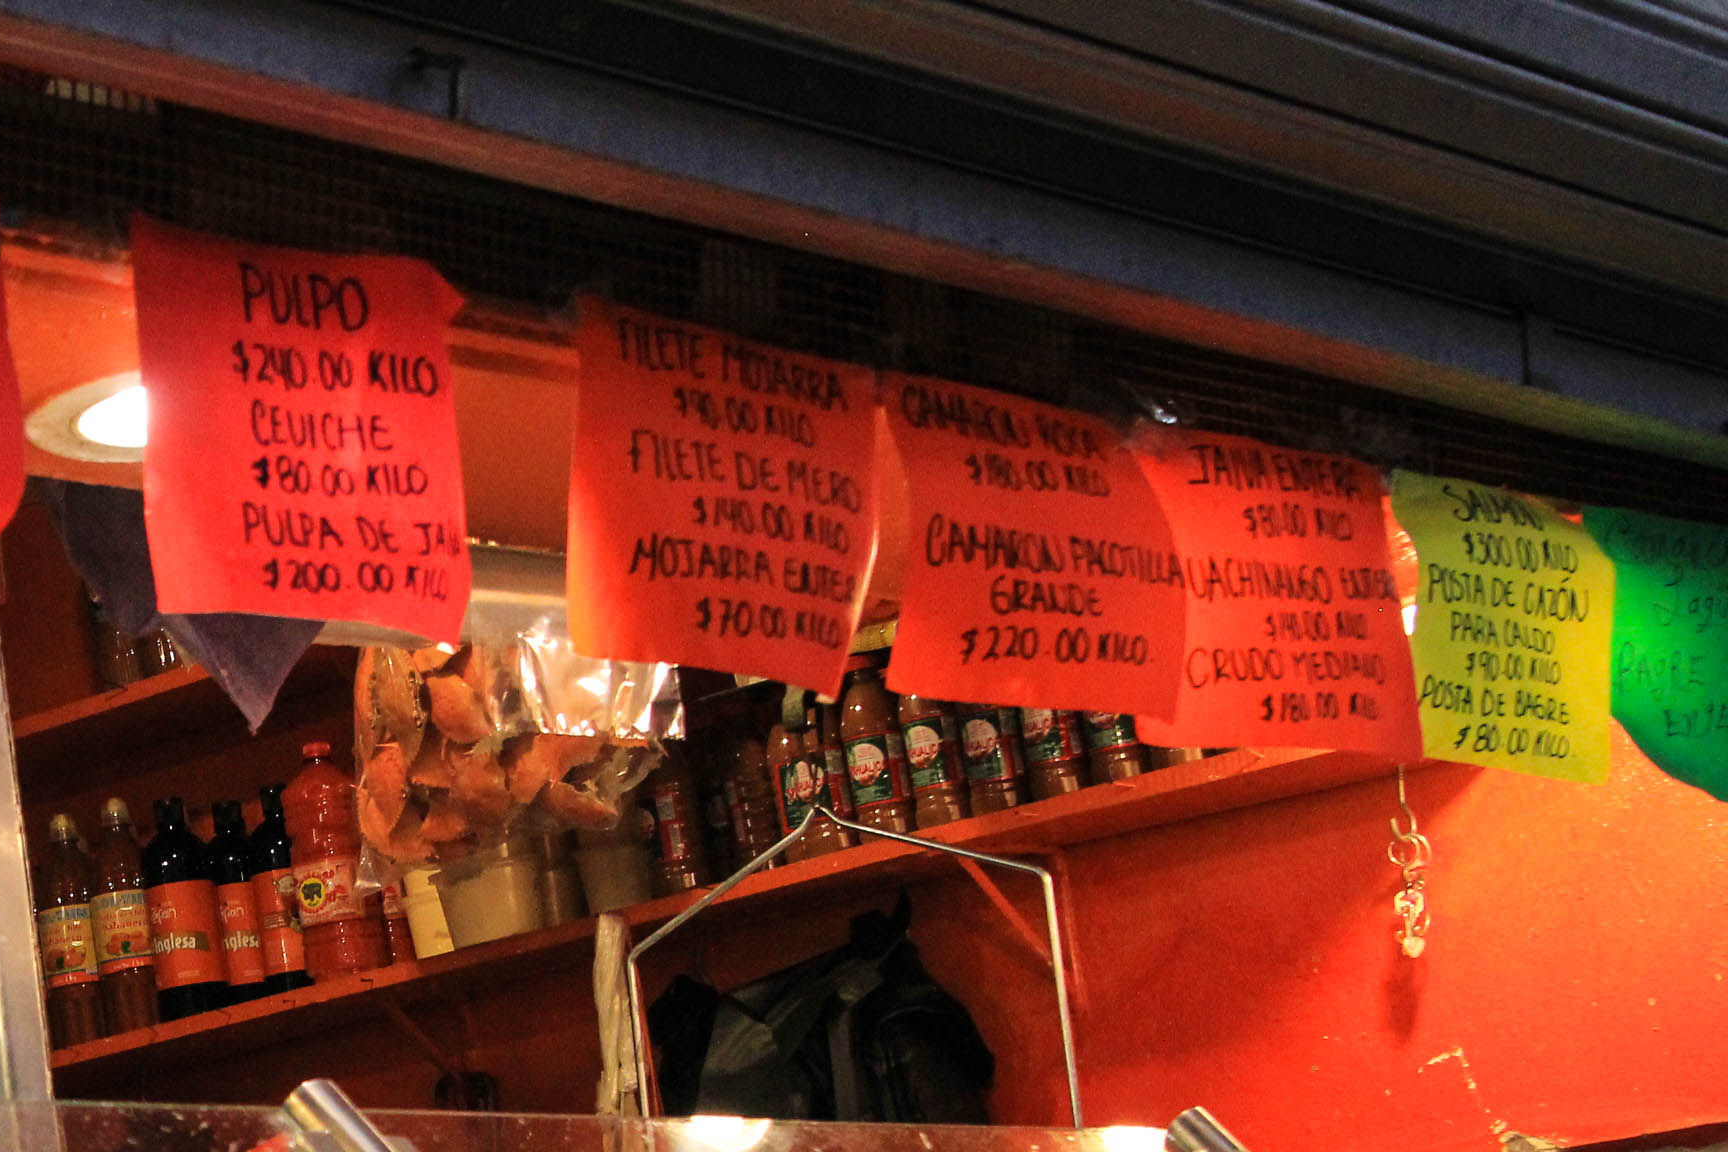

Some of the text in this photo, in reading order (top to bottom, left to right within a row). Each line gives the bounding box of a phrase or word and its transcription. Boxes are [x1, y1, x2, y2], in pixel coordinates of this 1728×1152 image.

[239, 261, 369, 332] PULPO
[232, 340, 440, 397] $240.00 KILO
[618, 318, 849, 411] FILETE MOJARRA
[367, 463, 429, 496] KILO
[628, 429, 862, 514] FILETE DE MERO
[242, 500, 344, 550] PULPA
[358, 514, 399, 555] DE
[803, 509, 850, 554] KILO
[630, 532, 774, 583] MOJARRA
[926, 514, 1187, 588] CAMARON PACOTILLA
[1543, 541, 1579, 574] KILO
[990, 575, 1103, 617] GRANDE
[1428, 563, 1486, 606] POSTA
[1491, 578, 1516, 608] DE
[794, 609, 841, 650] KILO
[1451, 611, 1557, 655] PARA CALDO
[1187, 649, 1385, 688] CRUDO MEDIANO
[1528, 657, 1562, 685] KILO
[1418, 674, 1570, 725] POSTA DE BAGRE
